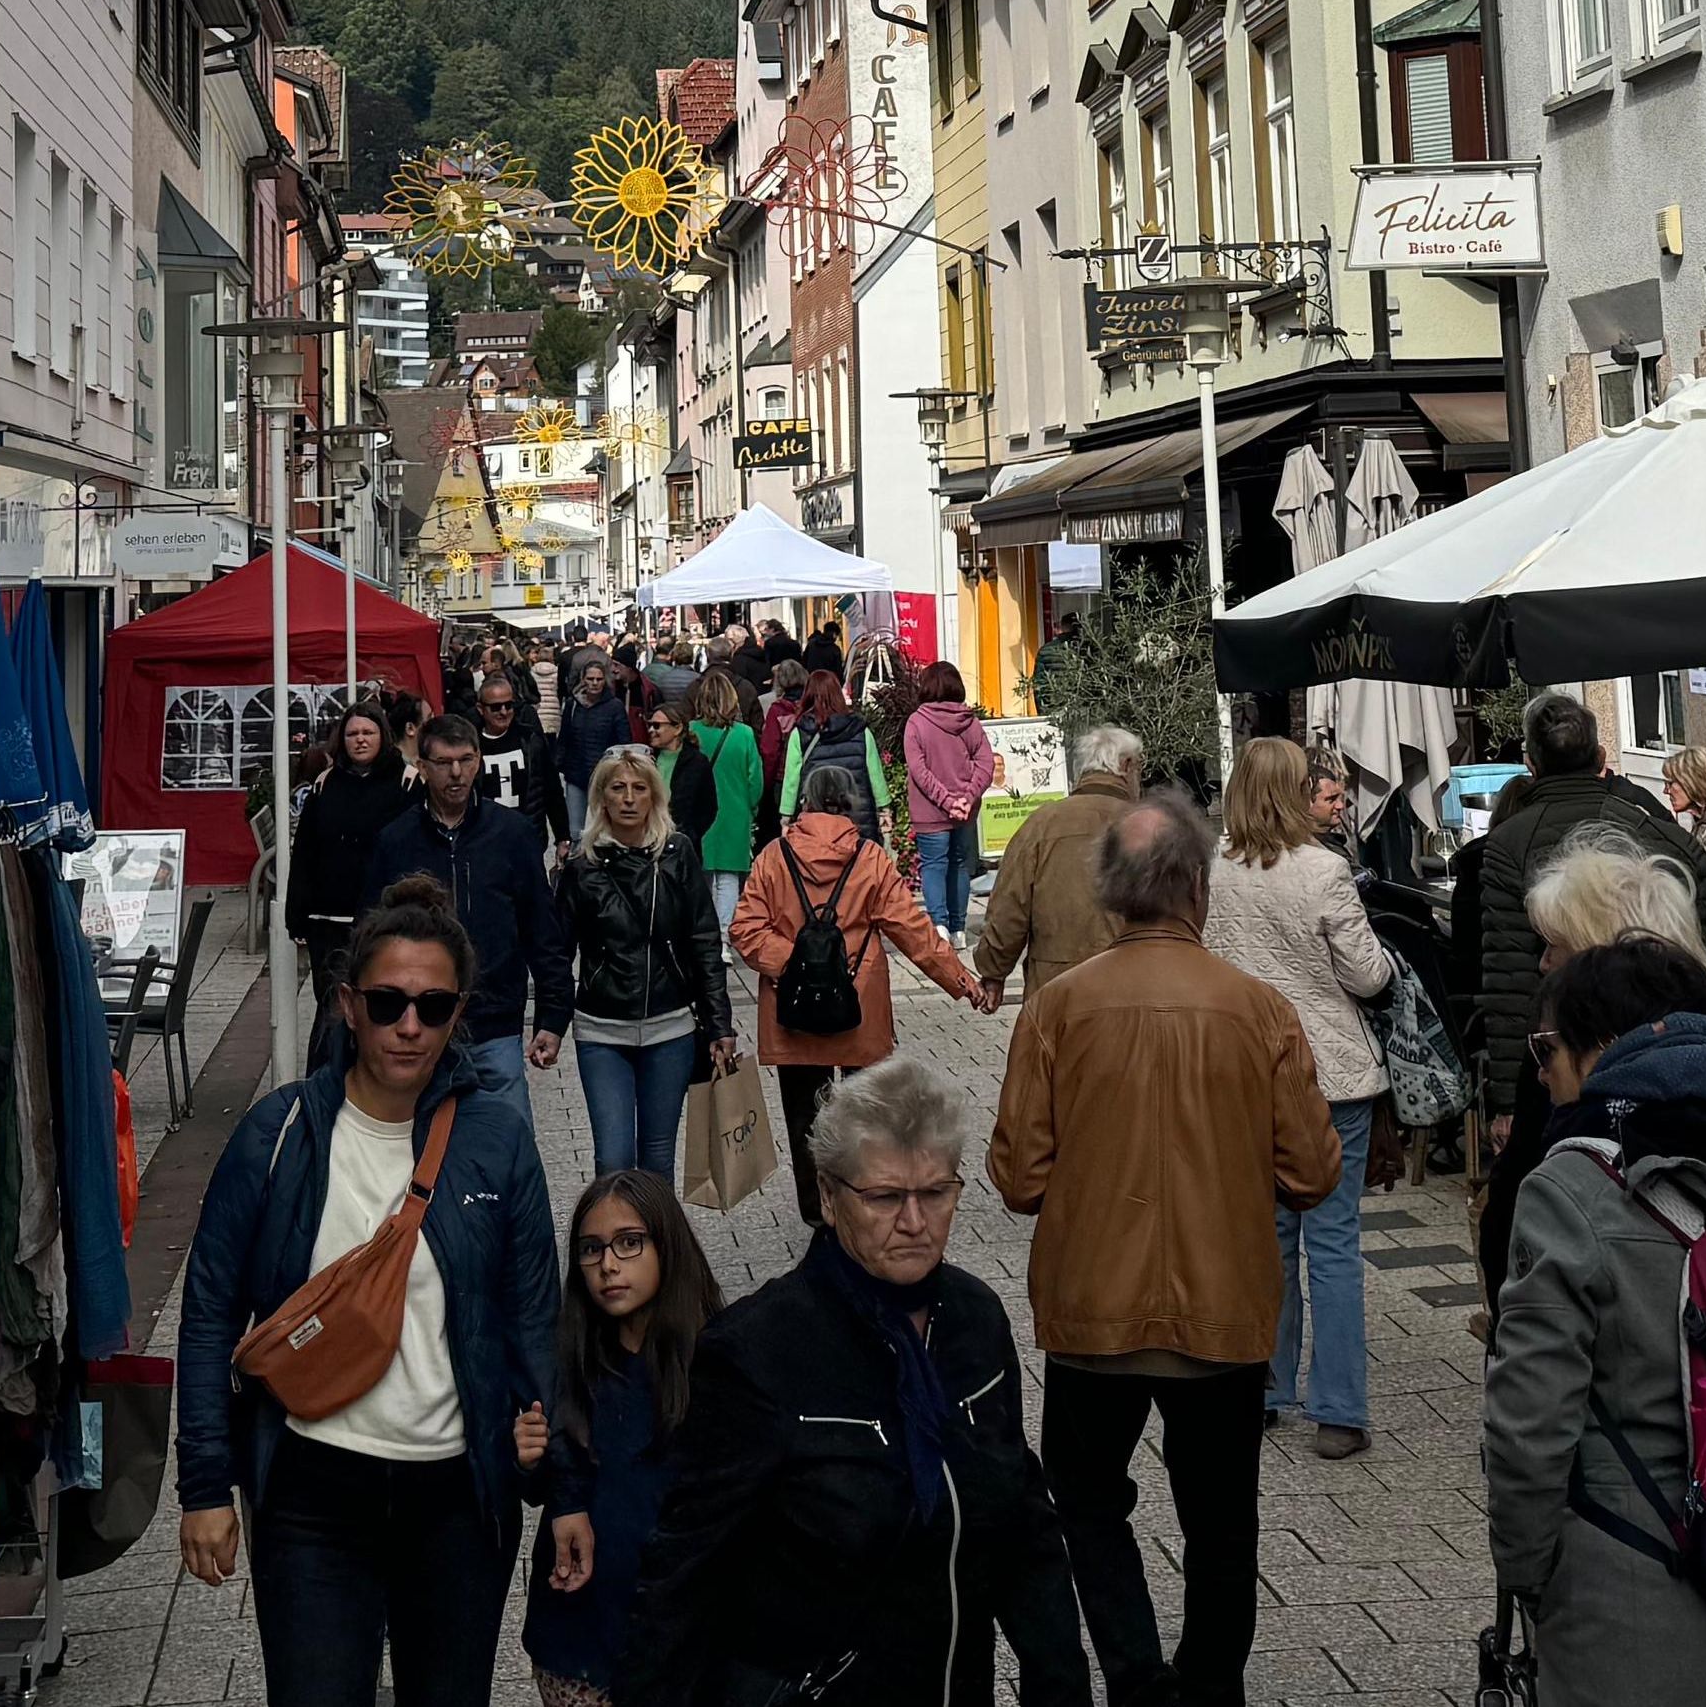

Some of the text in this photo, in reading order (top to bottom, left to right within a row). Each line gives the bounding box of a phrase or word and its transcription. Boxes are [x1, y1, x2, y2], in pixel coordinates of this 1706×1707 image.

[1374, 183, 1519, 260] Felicita
[1408, 237, 1503, 255] Bistro Café
[1101, 315, 1180, 336] Zins
[134, 245, 157, 444] Frey
[1122, 348, 1173, 362] Gegründet
[749, 420, 810, 435] CAFE
[738, 438, 810, 467] Bechtle
[173, 462, 209, 484] Frey
[125, 534, 160, 547] sehen
[163, 532, 206, 545] erleben
